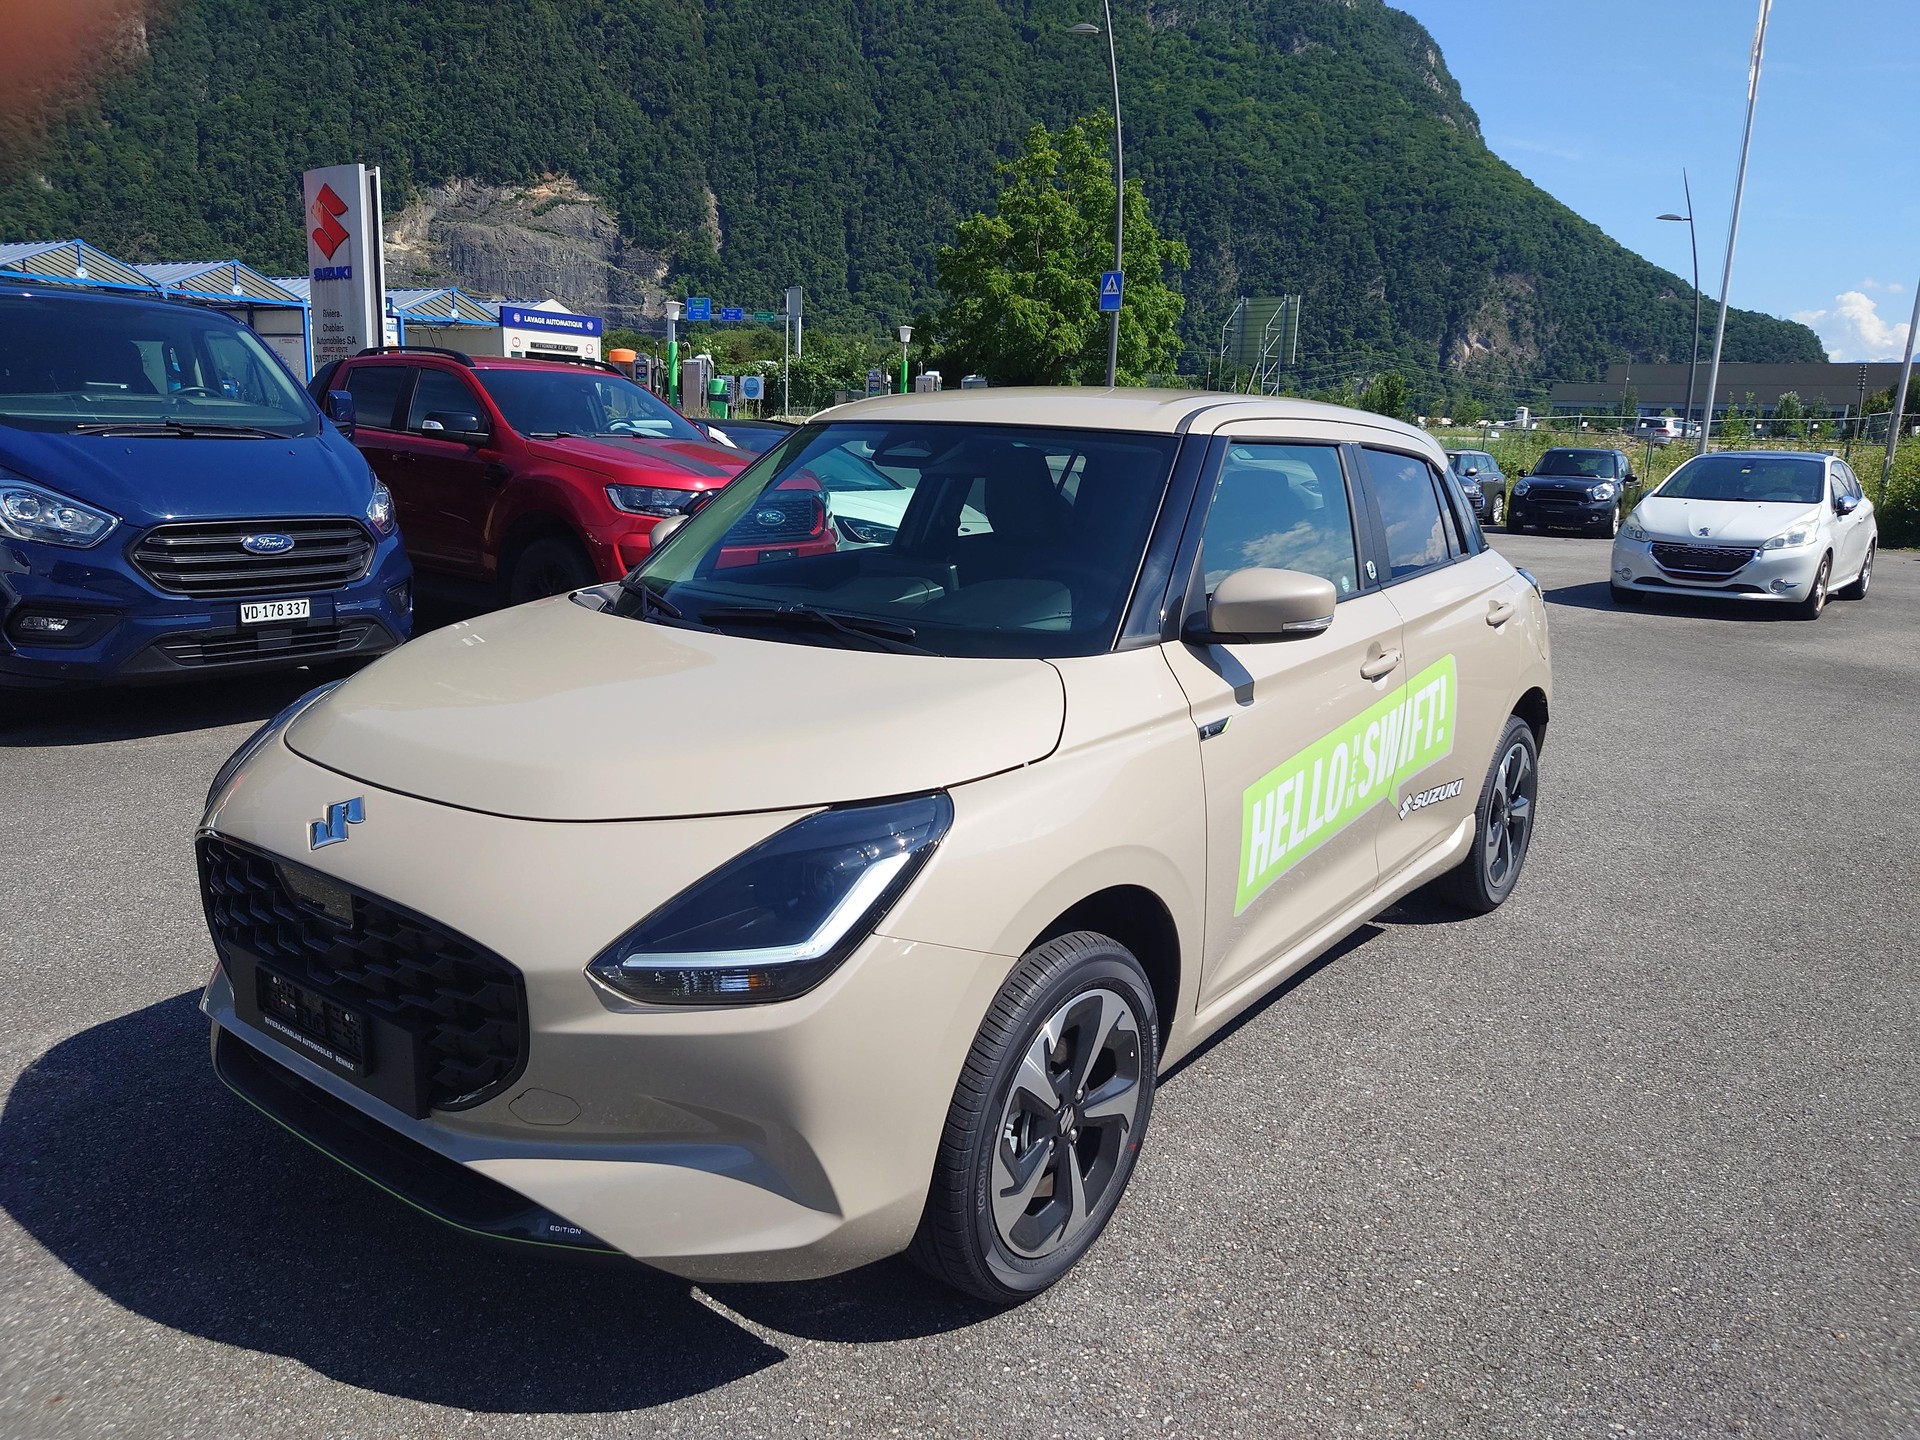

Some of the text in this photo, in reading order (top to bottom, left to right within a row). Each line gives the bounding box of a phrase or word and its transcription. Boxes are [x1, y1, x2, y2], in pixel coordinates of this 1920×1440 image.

[314, 266, 352, 281] SUZUKI
[323, 322, 345, 332] Chablais
[524, 316, 583, 328] LAVAGE AUTOMATIQUE
[316, 336, 357, 345] Automobiles SA
[257, 536, 285, 549] Ford
[1246, 741, 1348, 888] HELLO
[1358, 674, 1447, 799] SWIFT!
[1412, 778, 1464, 811] SUZUKI
[302, 1037, 333, 1059] AUTOMOBILES
[976, 1136, 992, 1215] YOKOHAMA
[549, 1224, 582, 1235] EDITION
